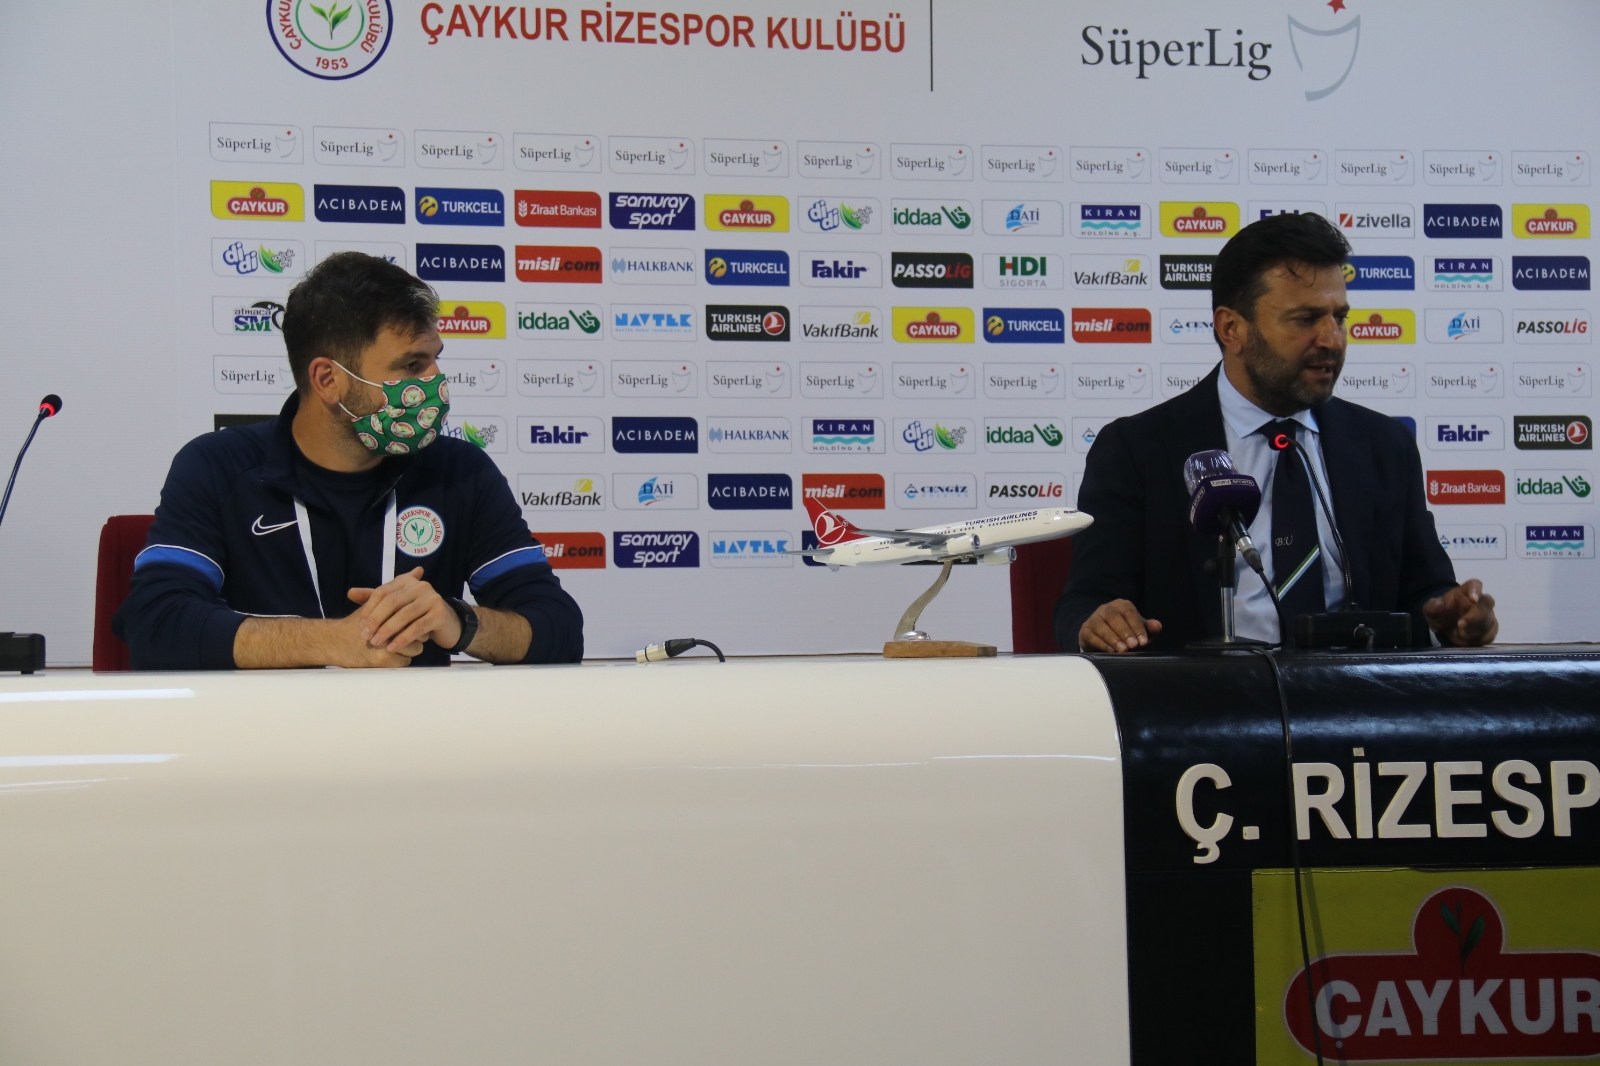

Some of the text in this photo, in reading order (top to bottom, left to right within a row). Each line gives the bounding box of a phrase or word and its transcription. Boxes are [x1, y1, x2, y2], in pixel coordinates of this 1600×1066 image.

[420, 1, 906, 53] ÇAYKUR RİZESPOR KULÜBÜ
[1081, 25, 1272, 81] SüperLig
[315, 56, 349, 70] 1953
[217, 136, 272, 153] SüperLig
[320, 140, 374, 156] SüperLig
[421, 144, 474, 160] SüperLig
[520, 147, 571, 162] SüperLig
[615, 149, 666, 165] SüperLig
[710, 152, 760, 167] SüperLig
[804, 154, 853, 169] SüperLig
[897, 156, 945, 171] SüperLig
[988, 158, 1036, 173] SüperLig
[1076, 160, 1124, 174] SüperLig
[1165, 161, 1212, 175] SüperLig
[1254, 162, 1300, 176] SüperLig
[1341, 163, 1387, 176] SüperLig
[1429, 163, 1476, 177] SüperLig
[1517, 163, 1563, 177] SüperLig
[230, 200, 286, 216] ÇAYKUR
[318, 198, 403, 213] ACIBADEM
[442, 200, 502, 215] TURKCELL
[530, 203, 597, 218] Ziraat Bankası
[615, 195, 690, 214] samuray
[722, 212, 772, 226] ÇAYKUR
[893, 207, 943, 226] iddaa
[1085, 209, 1137, 217] KIRAN
[1356, 212, 1411, 228] zivella
[629, 211, 676, 230] sport
[1177, 219, 1224, 232] ÇAYKUR
[1427, 216, 1500, 227] ACIBADEM
[1529, 220, 1575, 234] ÇAYKUR
[420, 257, 502, 270] ACIBADEM
[517, 257, 600, 272] misli.com
[627, 261, 694, 272] HALKBANK
[731, 262, 787, 274] TURKCELL
[812, 260, 867, 279] Fakir
[1000, 256, 1047, 276] HDI
[1165, 263, 1212, 273] TURKISH
[1438, 262, 1489, 270] KIRAN
[1074, 270, 1148, 285] VakıfBank
[1165, 272, 1212, 282] AIRLINES
[1359, 267, 1412, 279] TURKCELL
[1516, 268, 1588, 279] ACIBADEM
[234, 315, 272, 332] SM
[437, 319, 488, 332] ÇAYKUR
[519, 312, 570, 330] iddaa
[615, 313, 692, 327] NAVTEK
[711, 314, 761, 323] TURKISH
[1074, 319, 1150, 332] misli.com
[711, 323, 761, 333] AIRLINES
[803, 324, 879, 338] VakıfBank
[910, 325, 957, 337] ÇAYKUR
[1007, 320, 1062, 332] TURKCELL
[1353, 326, 1399, 337] ÇAYKUR
[221, 370, 275, 385] SüperLig
[523, 373, 574, 387] SüperLig
[618, 374, 668, 388] SüperLig
[713, 375, 762, 388] SüperLig
[806, 375, 855, 389] SüperLig
[899, 375, 947, 389] SüperLig
[990, 376, 1037, 389] SüperLig
[1078, 376, 1125, 389] SüperLig
[1342, 375, 1389, 388] SüperLig
[1431, 375, 1477, 388] SüperLig
[1519, 375, 1564, 388] SüperLig
[531, 425, 588, 444] Fakir
[817, 423, 871, 432] KIRAN
[986, 426, 1034, 443] iddaa
[1438, 424, 1490, 442] Fakir
[1519, 424, 1565, 432] TURKISH
[616, 430, 696, 441] ACIBADEM
[724, 430, 789, 440] HALKBANK
[1519, 433, 1565, 442] AIRLINES
[711, 487, 789, 497] ACIBADEM
[805, 485, 883, 498] misli.com
[1441, 483, 1501, 493] Ziraat Bankası
[1517, 478, 1563, 495] iddaa
[522, 491, 602, 506] VakıfBank
[965, 510, 1038, 526] TURKISH AIRLINES
[1530, 530, 1580, 538] KIRAN
[620, 534, 693, 550] samuray
[713, 540, 788, 554] NAVTEK
[542, 544, 603, 558] isli.com
[633, 547, 680, 567] sport
[1175, 747, 1600, 864] Ç. RİZESP
[1315, 979, 1600, 1049] ÇAYKUR
